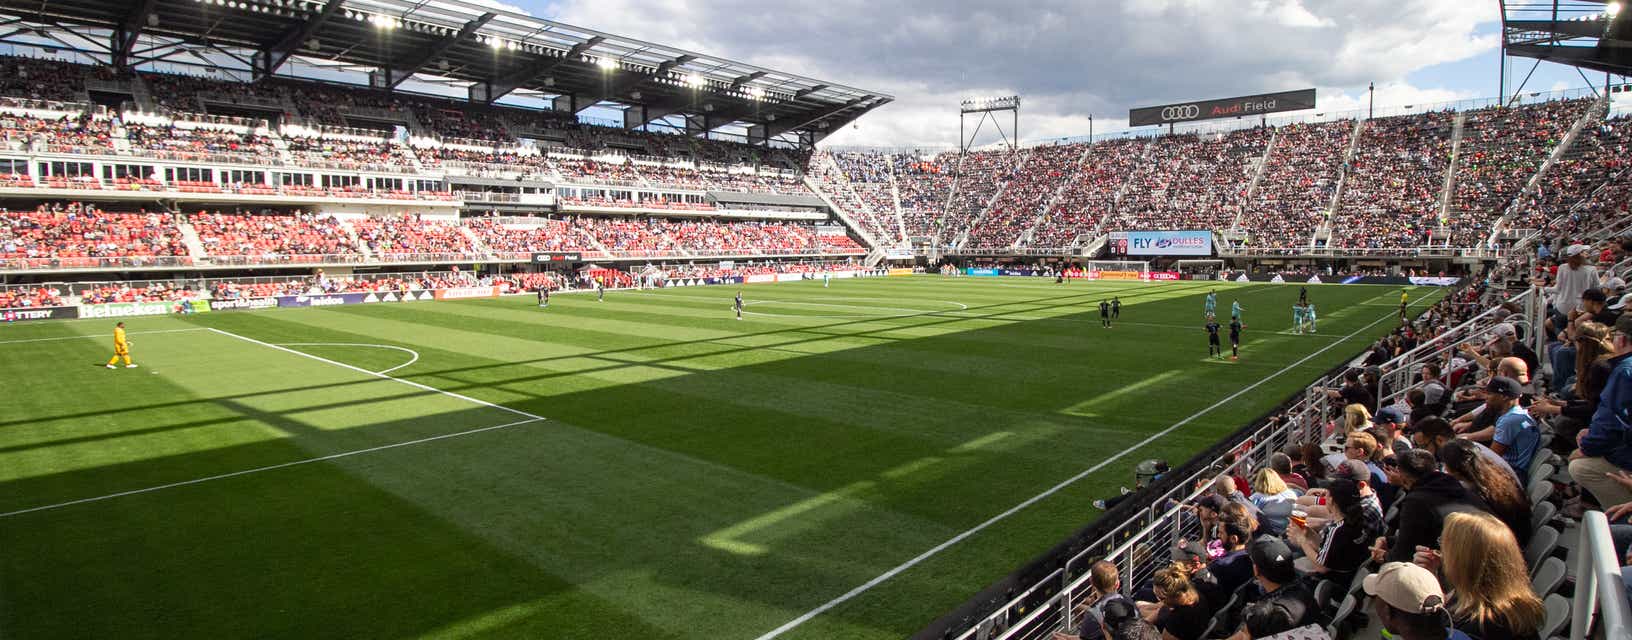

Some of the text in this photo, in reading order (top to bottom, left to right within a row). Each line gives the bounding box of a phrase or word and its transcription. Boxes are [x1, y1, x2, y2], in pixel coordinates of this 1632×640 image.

[1211, 100, 1277, 115] Audi Field
[1134, 238, 1151, 248] FLY
[310, 296, 344, 306] leidos
[80, 303, 167, 318] Heineken
